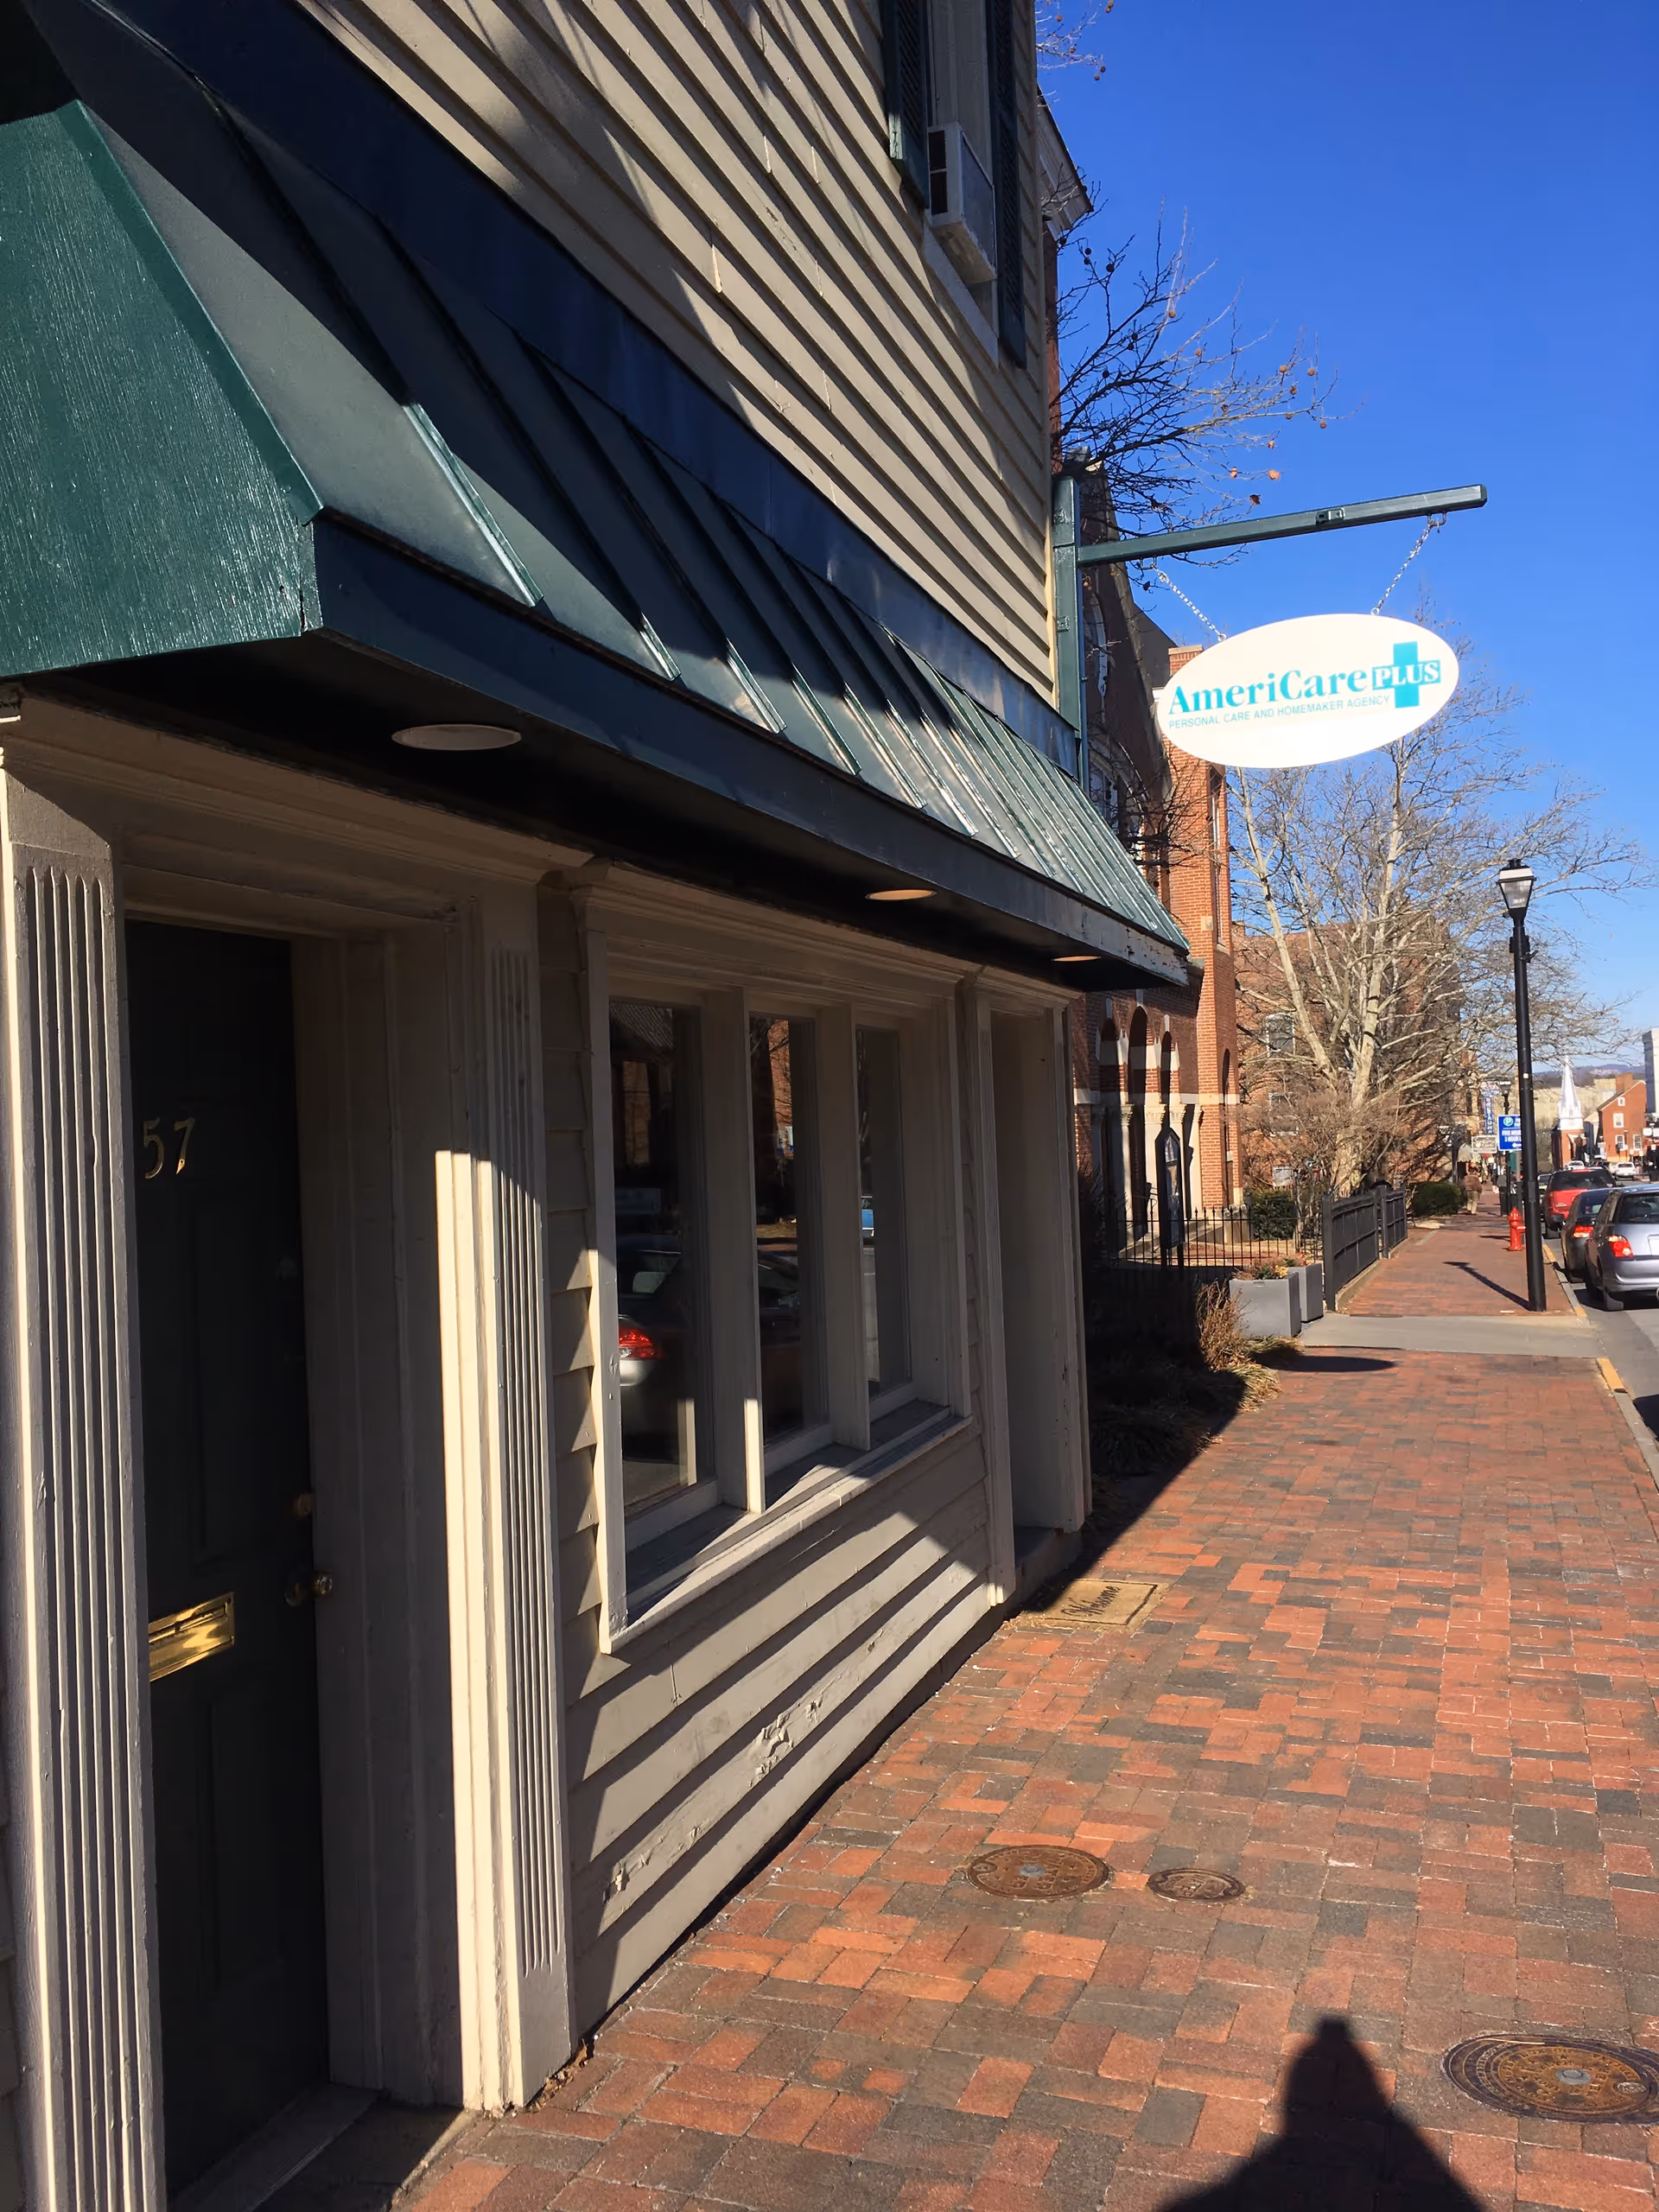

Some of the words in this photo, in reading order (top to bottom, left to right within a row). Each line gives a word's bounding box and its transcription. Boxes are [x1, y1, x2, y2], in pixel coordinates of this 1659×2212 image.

[1168, 669, 1368, 715] AmeriCare
[1375, 662, 1440, 688] PLUS
[1169, 715, 1220, 729] PERSONAL
[1224, 711, 1250, 723] CARE
[1254, 708, 1274, 719] AND
[1277, 700, 1344, 716] HOMEMAKER
[1347, 695, 1389, 709] AGENCY
[143, 1116, 195, 1179] 57
